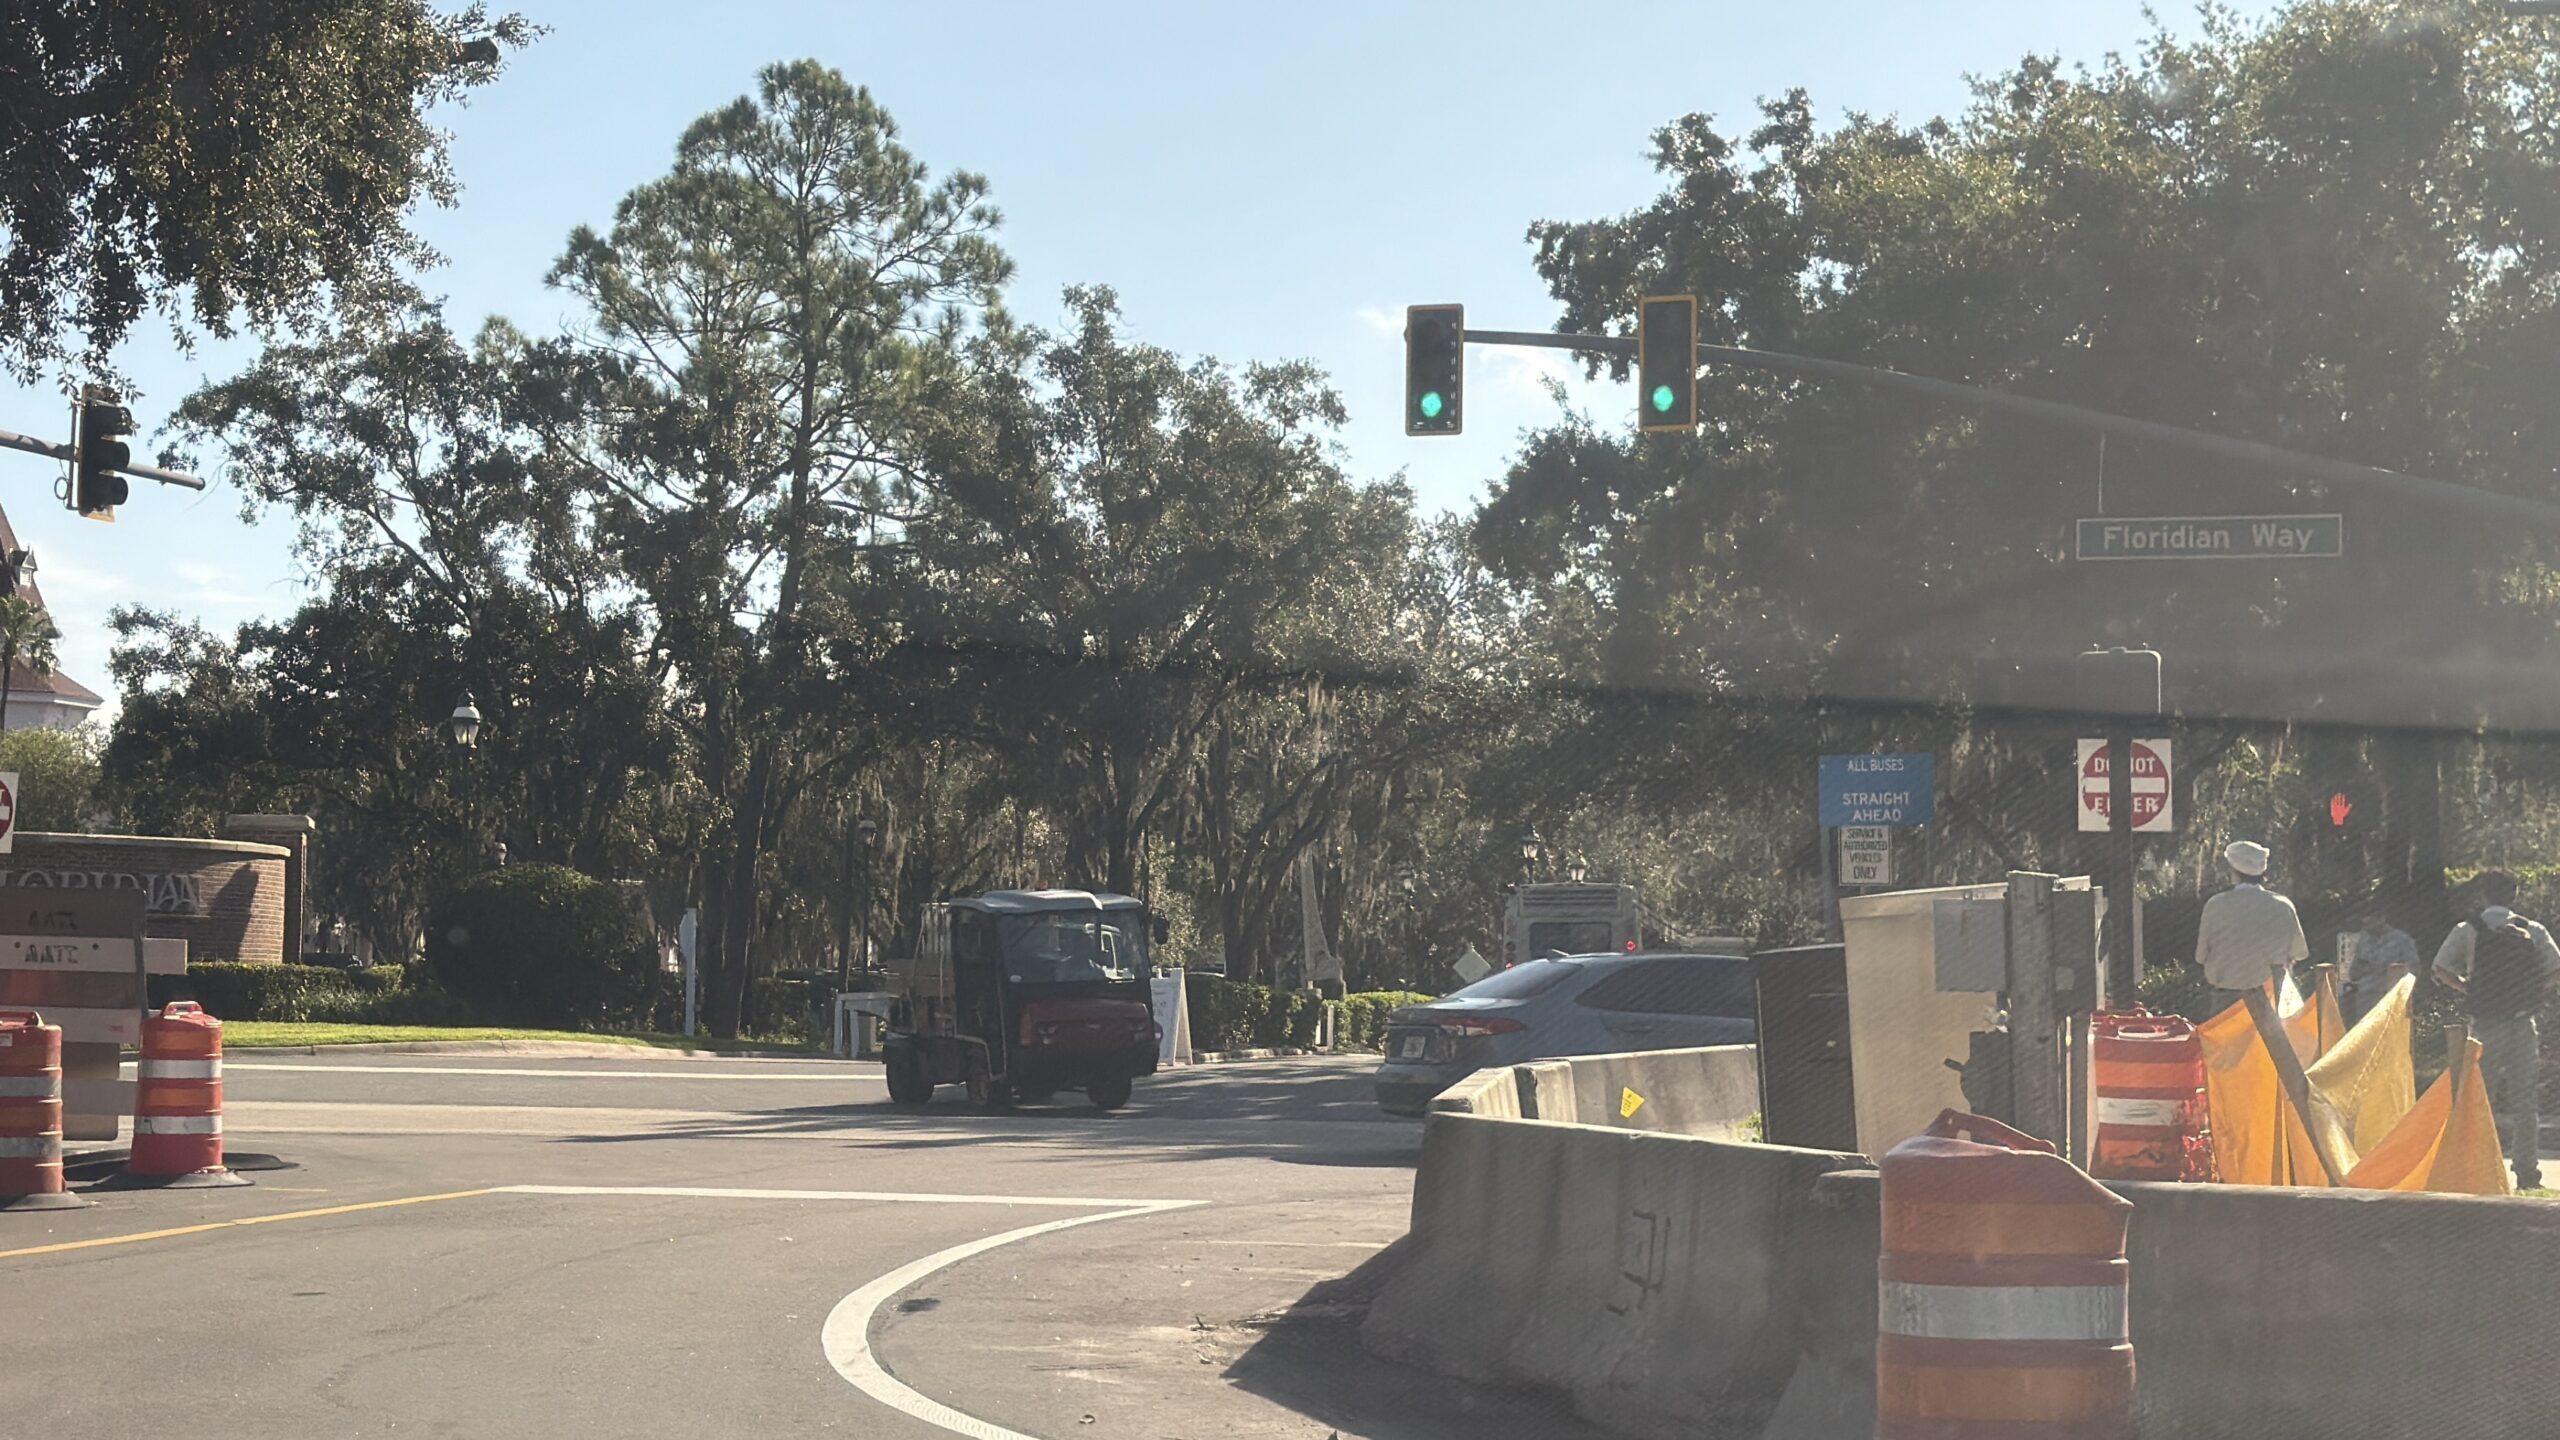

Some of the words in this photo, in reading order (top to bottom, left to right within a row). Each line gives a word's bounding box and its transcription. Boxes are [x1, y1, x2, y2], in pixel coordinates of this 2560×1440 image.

[2103, 525, 2230, 550] Floridian
[2252, 523, 2314, 551] Way
[1847, 760, 1868, 772] ALL
[1870, 758, 1905, 772] BUSES
[1842, 791, 1911, 806] STRAIGHT
[2094, 796, 2159, 813] EER
[1852, 808, 1902, 821] AHEAD
[1853, 866, 1878, 879] ONLY
